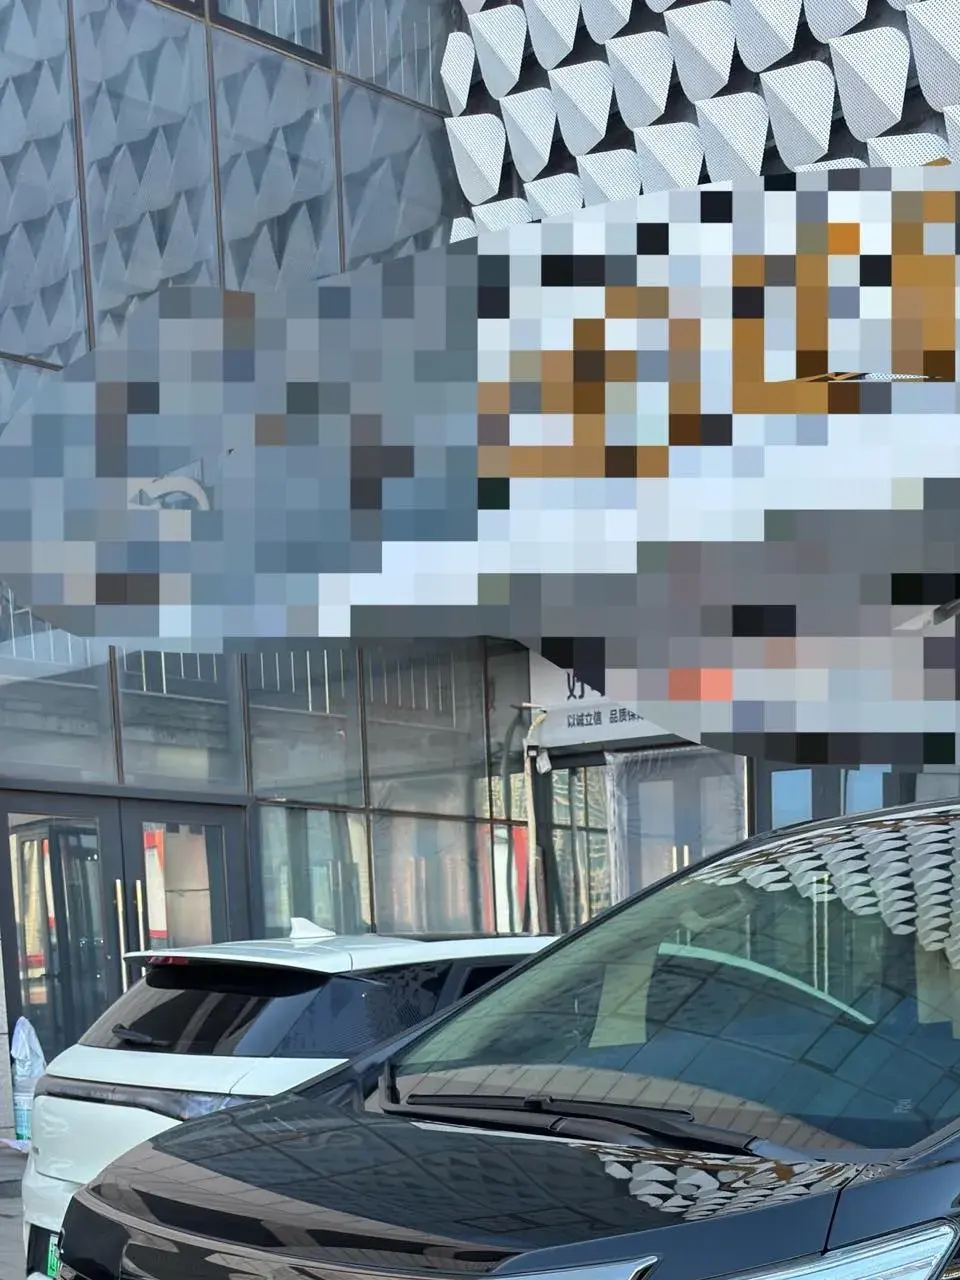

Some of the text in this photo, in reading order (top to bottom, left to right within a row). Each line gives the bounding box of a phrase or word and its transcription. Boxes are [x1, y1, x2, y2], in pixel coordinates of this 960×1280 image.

[567, 708, 644, 728] 以诚立信 品质保
